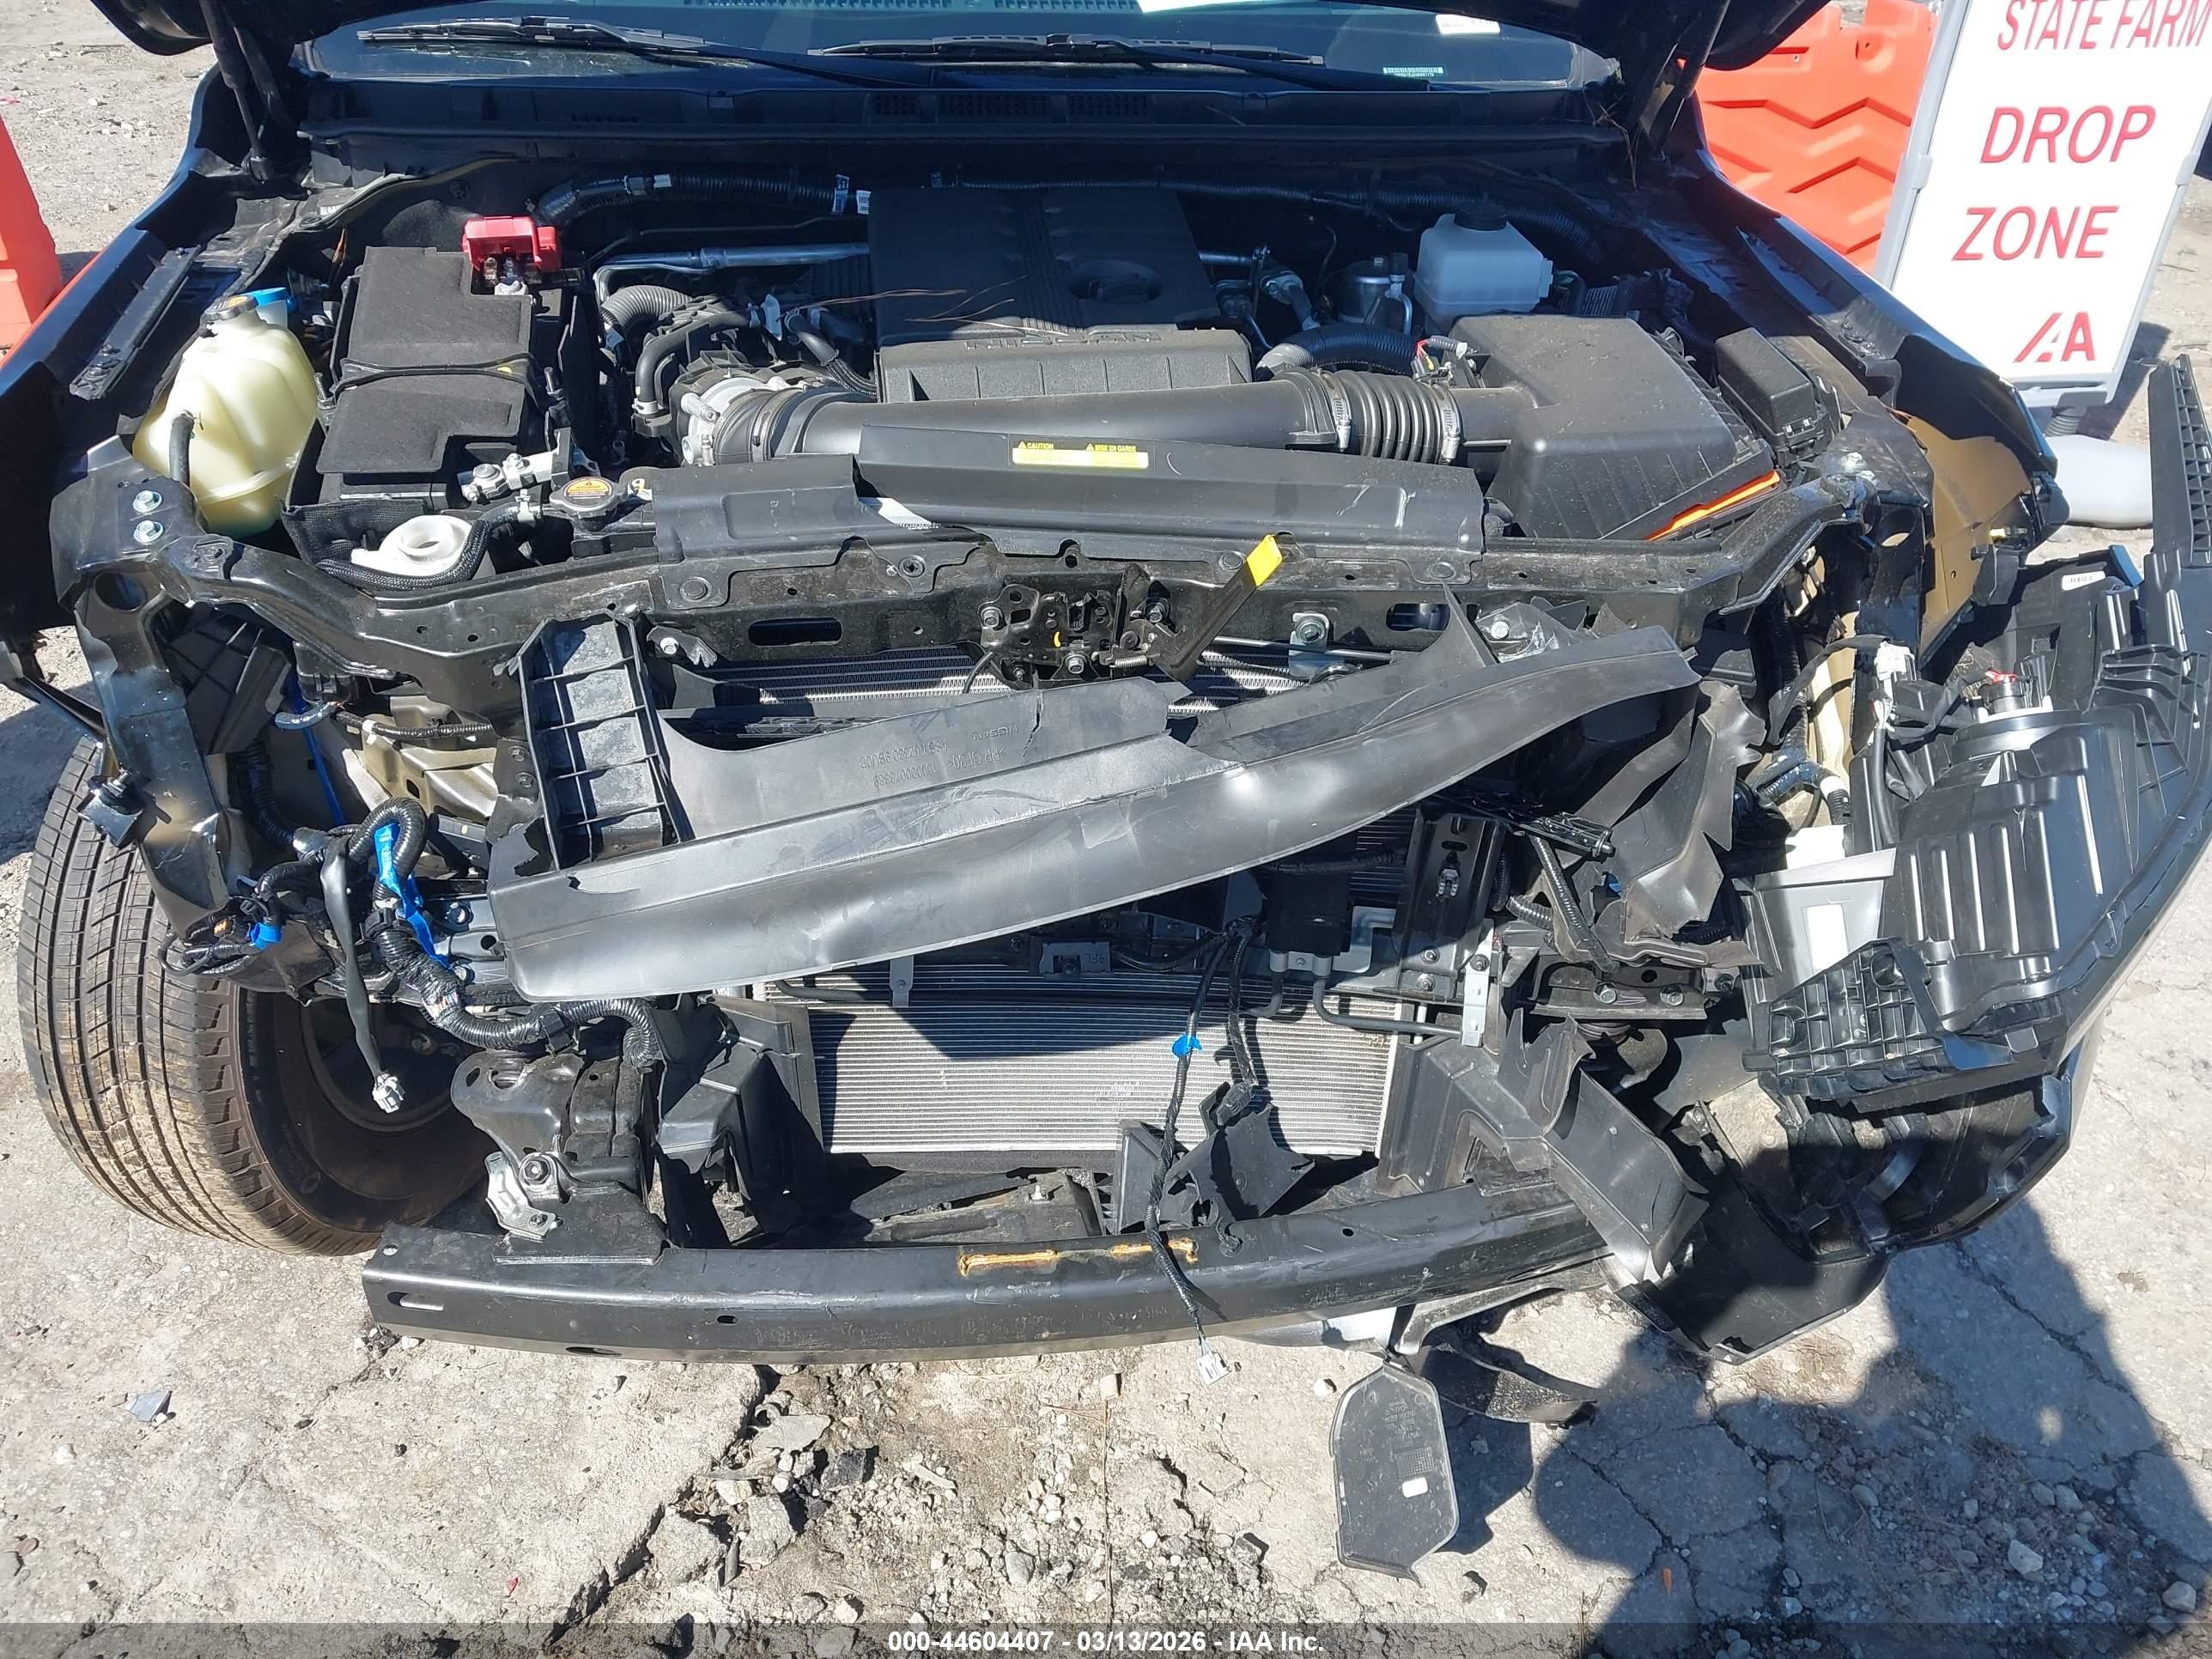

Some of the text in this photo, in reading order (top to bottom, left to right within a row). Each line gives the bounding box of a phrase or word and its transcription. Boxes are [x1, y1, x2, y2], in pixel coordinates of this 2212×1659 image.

[1997, 0, 2212, 50] STATE FARM
[1980, 106, 2156, 164] DROP
[1952, 206, 2118, 261] ZONE
